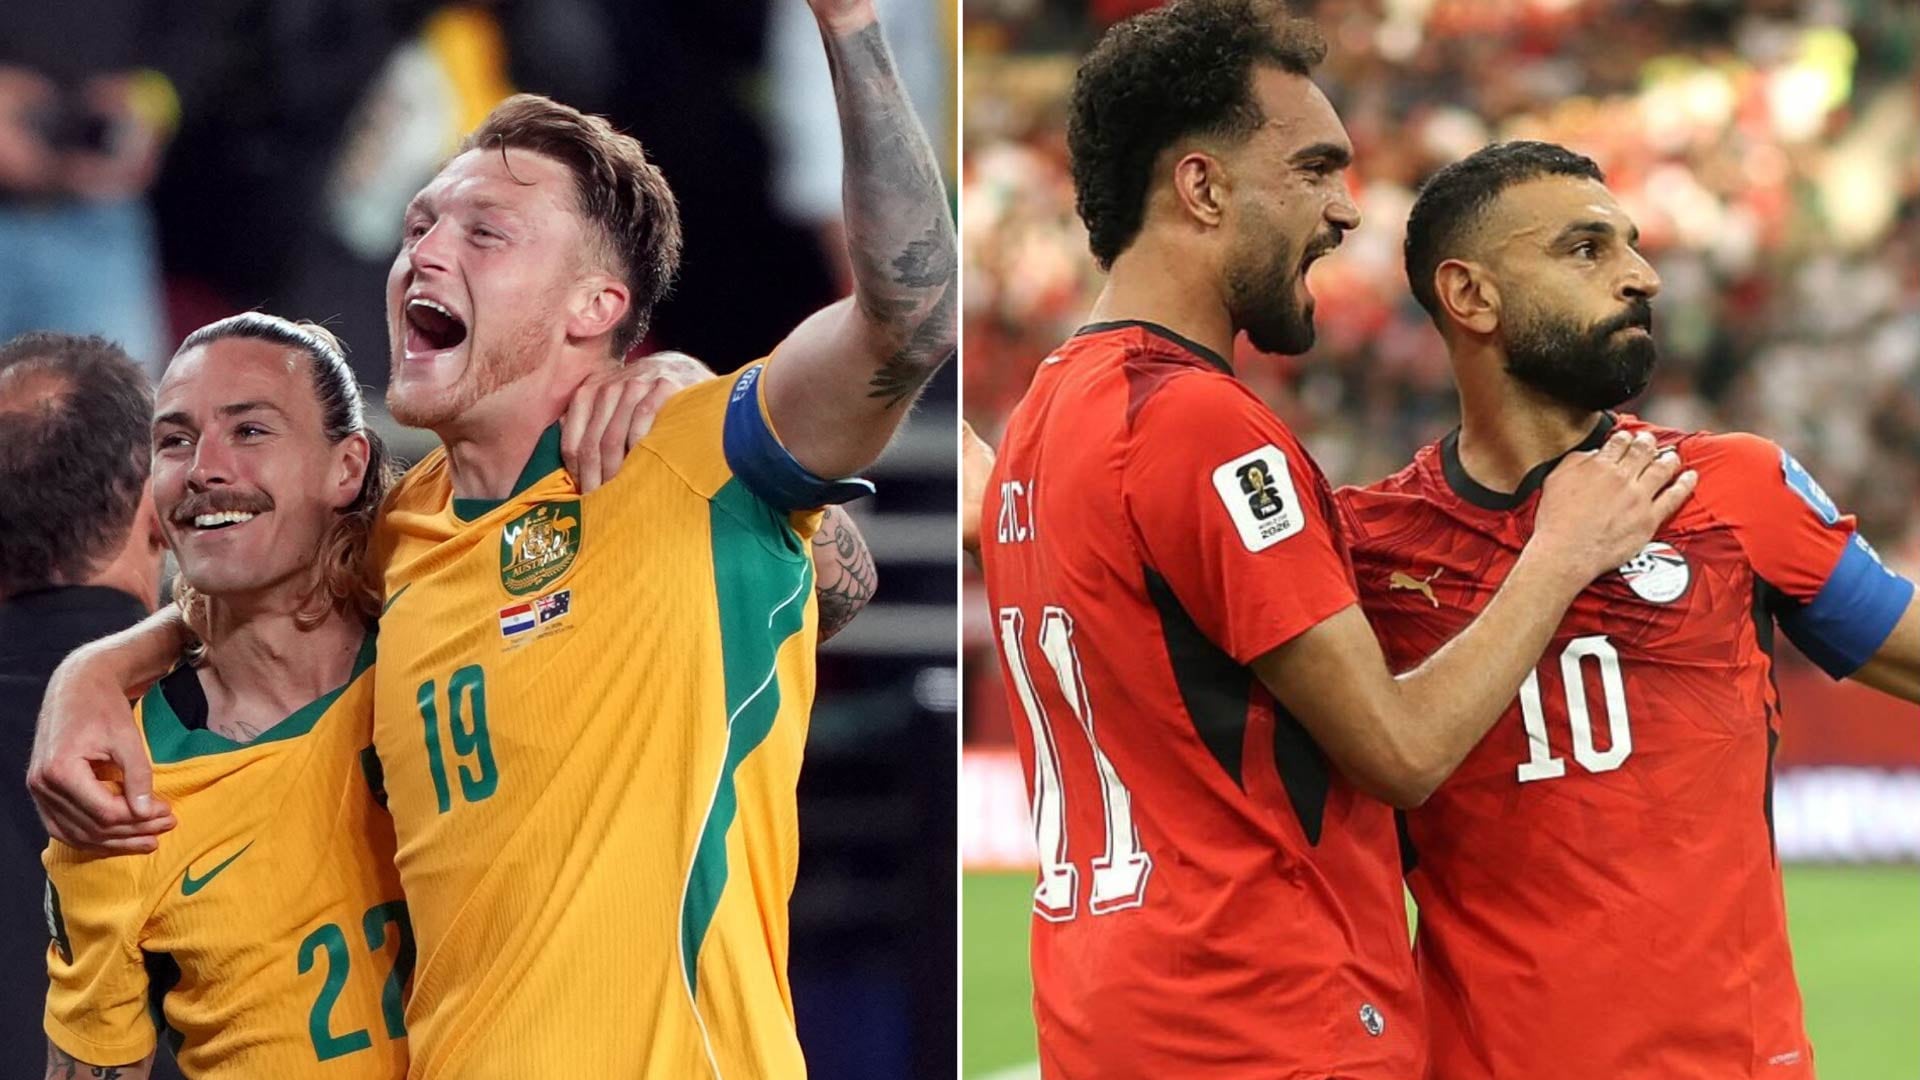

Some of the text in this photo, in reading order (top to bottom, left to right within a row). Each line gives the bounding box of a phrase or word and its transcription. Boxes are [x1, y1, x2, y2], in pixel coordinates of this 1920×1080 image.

[1261, 520, 1290, 539] 2026
[416, 664, 499, 814] 19
[1000, 606, 1152, 922] 11
[1517, 635, 1633, 782] 10
[297, 900, 418, 1062] 22
